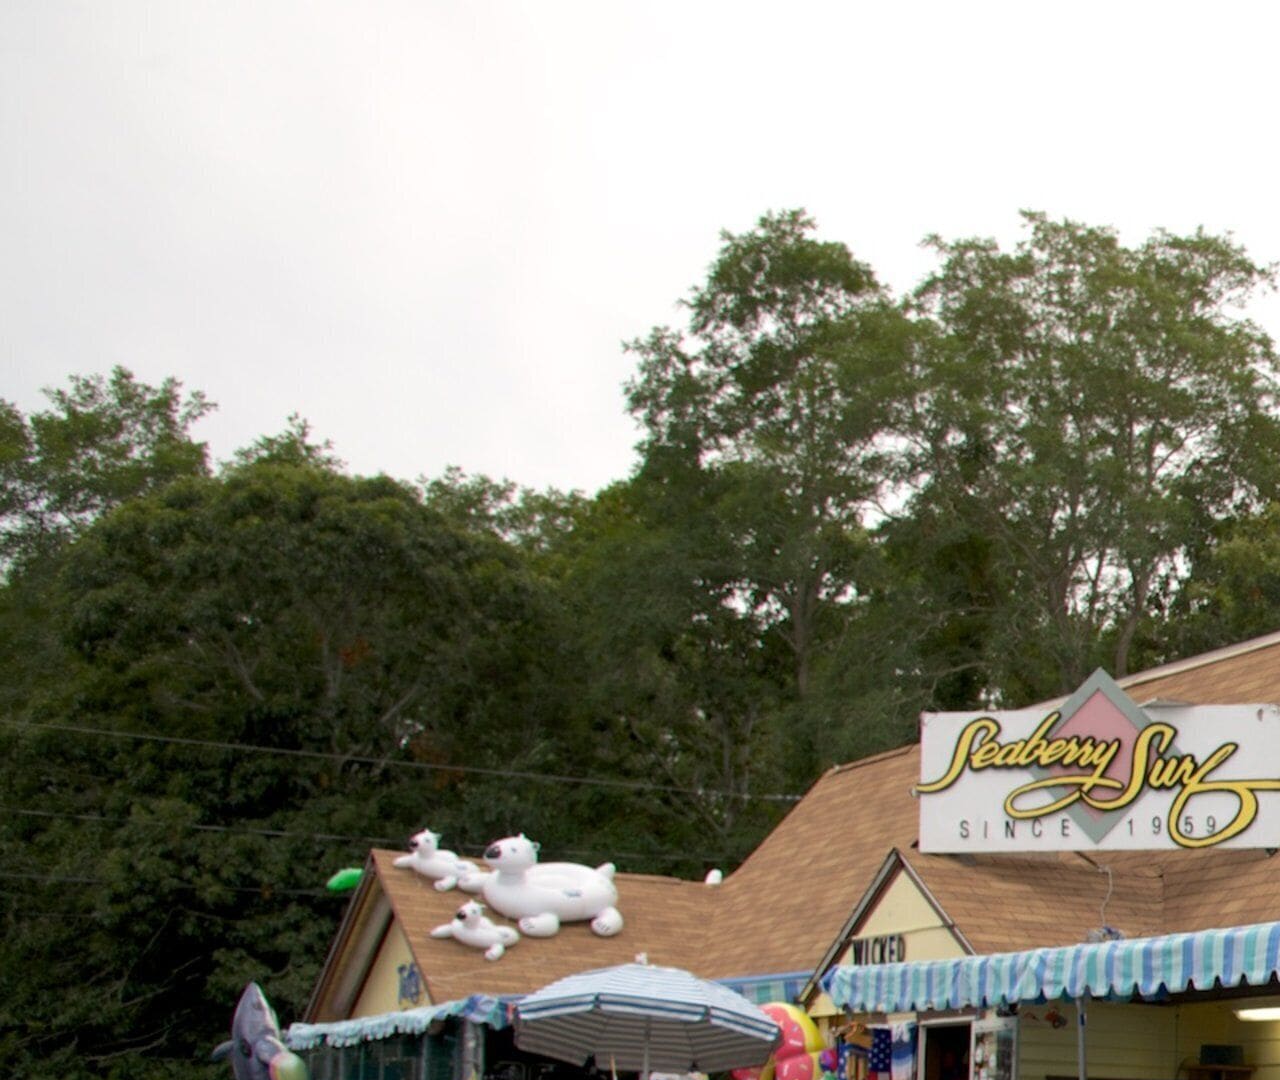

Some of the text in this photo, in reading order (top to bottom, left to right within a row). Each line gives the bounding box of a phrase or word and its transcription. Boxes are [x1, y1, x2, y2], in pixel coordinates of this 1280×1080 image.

[915, 711, 1125, 819] Seaberry
[960, 815, 1217, 839] SINCE 1959
[853, 933, 906, 966] WICKED
